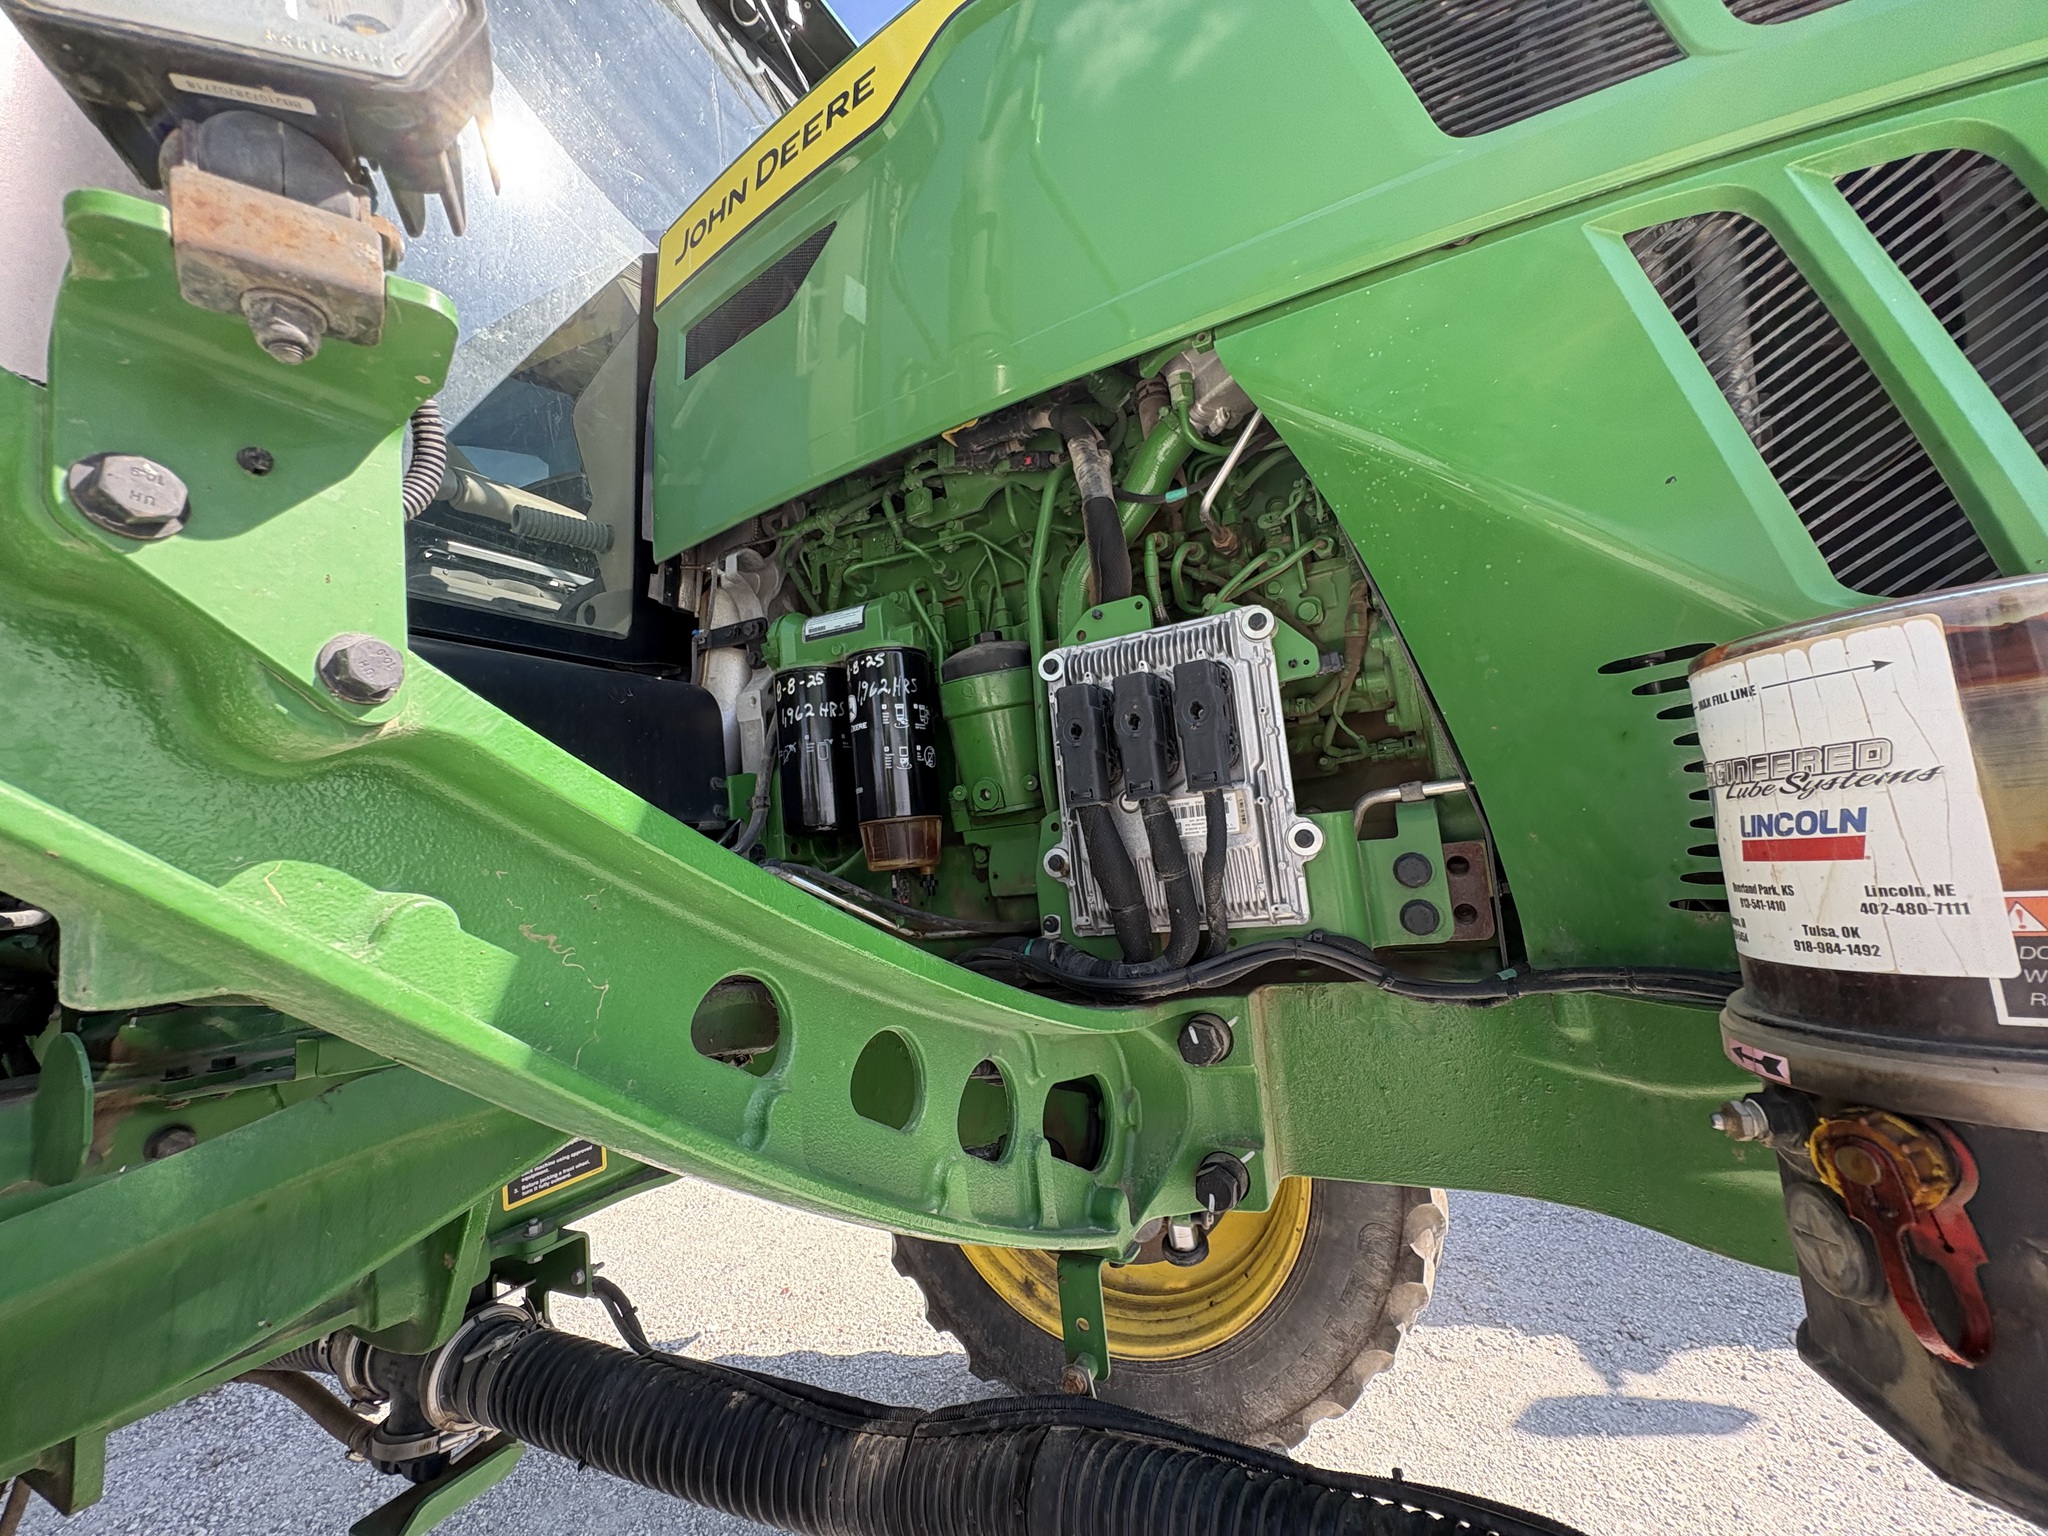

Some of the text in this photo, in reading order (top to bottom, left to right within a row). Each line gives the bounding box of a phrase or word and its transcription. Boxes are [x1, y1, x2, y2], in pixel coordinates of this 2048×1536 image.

[675, 66, 876, 266] JOHN DEERE
[892, 676, 917, 697] HRS
[1698, 685, 1757, 711] MAX FILL LINE
[819, 701, 845, 717] HRS
[1704, 738, 1893, 787] NGINEERED
[1726, 765, 1944, 800] Lube Systems
[1740, 807, 1867, 837] LINCOLN
[1781, 885, 1795, 896] KS
[1864, 883, 1956, 898] Lincoln, NE
[1860, 902, 1971, 915] 402-480-7111
[1801, 924, 1861, 939] Tulsa, OK
[1793, 940, 1881, 957] 918-984-1492
